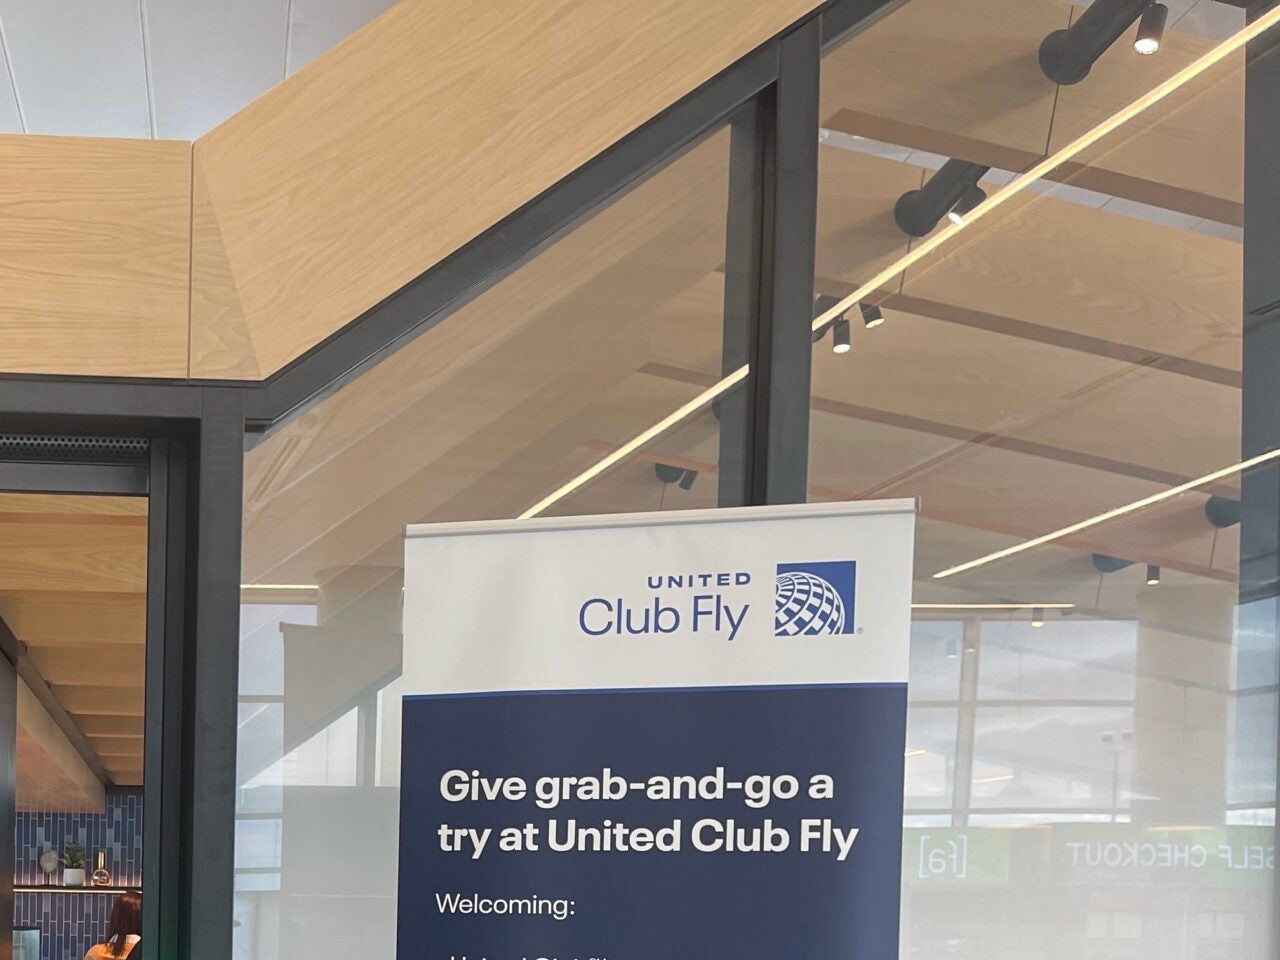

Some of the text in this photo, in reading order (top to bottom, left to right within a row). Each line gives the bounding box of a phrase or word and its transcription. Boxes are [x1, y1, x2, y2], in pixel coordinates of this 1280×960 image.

[648, 573, 750, 589] UNITED
[580, 595, 749, 640] Club Fly
[441, 767, 833, 808] Give grab-and-go a
[438, 819, 859, 860] try at United Club Fly
[436, 894, 574, 920] Welcoming:
